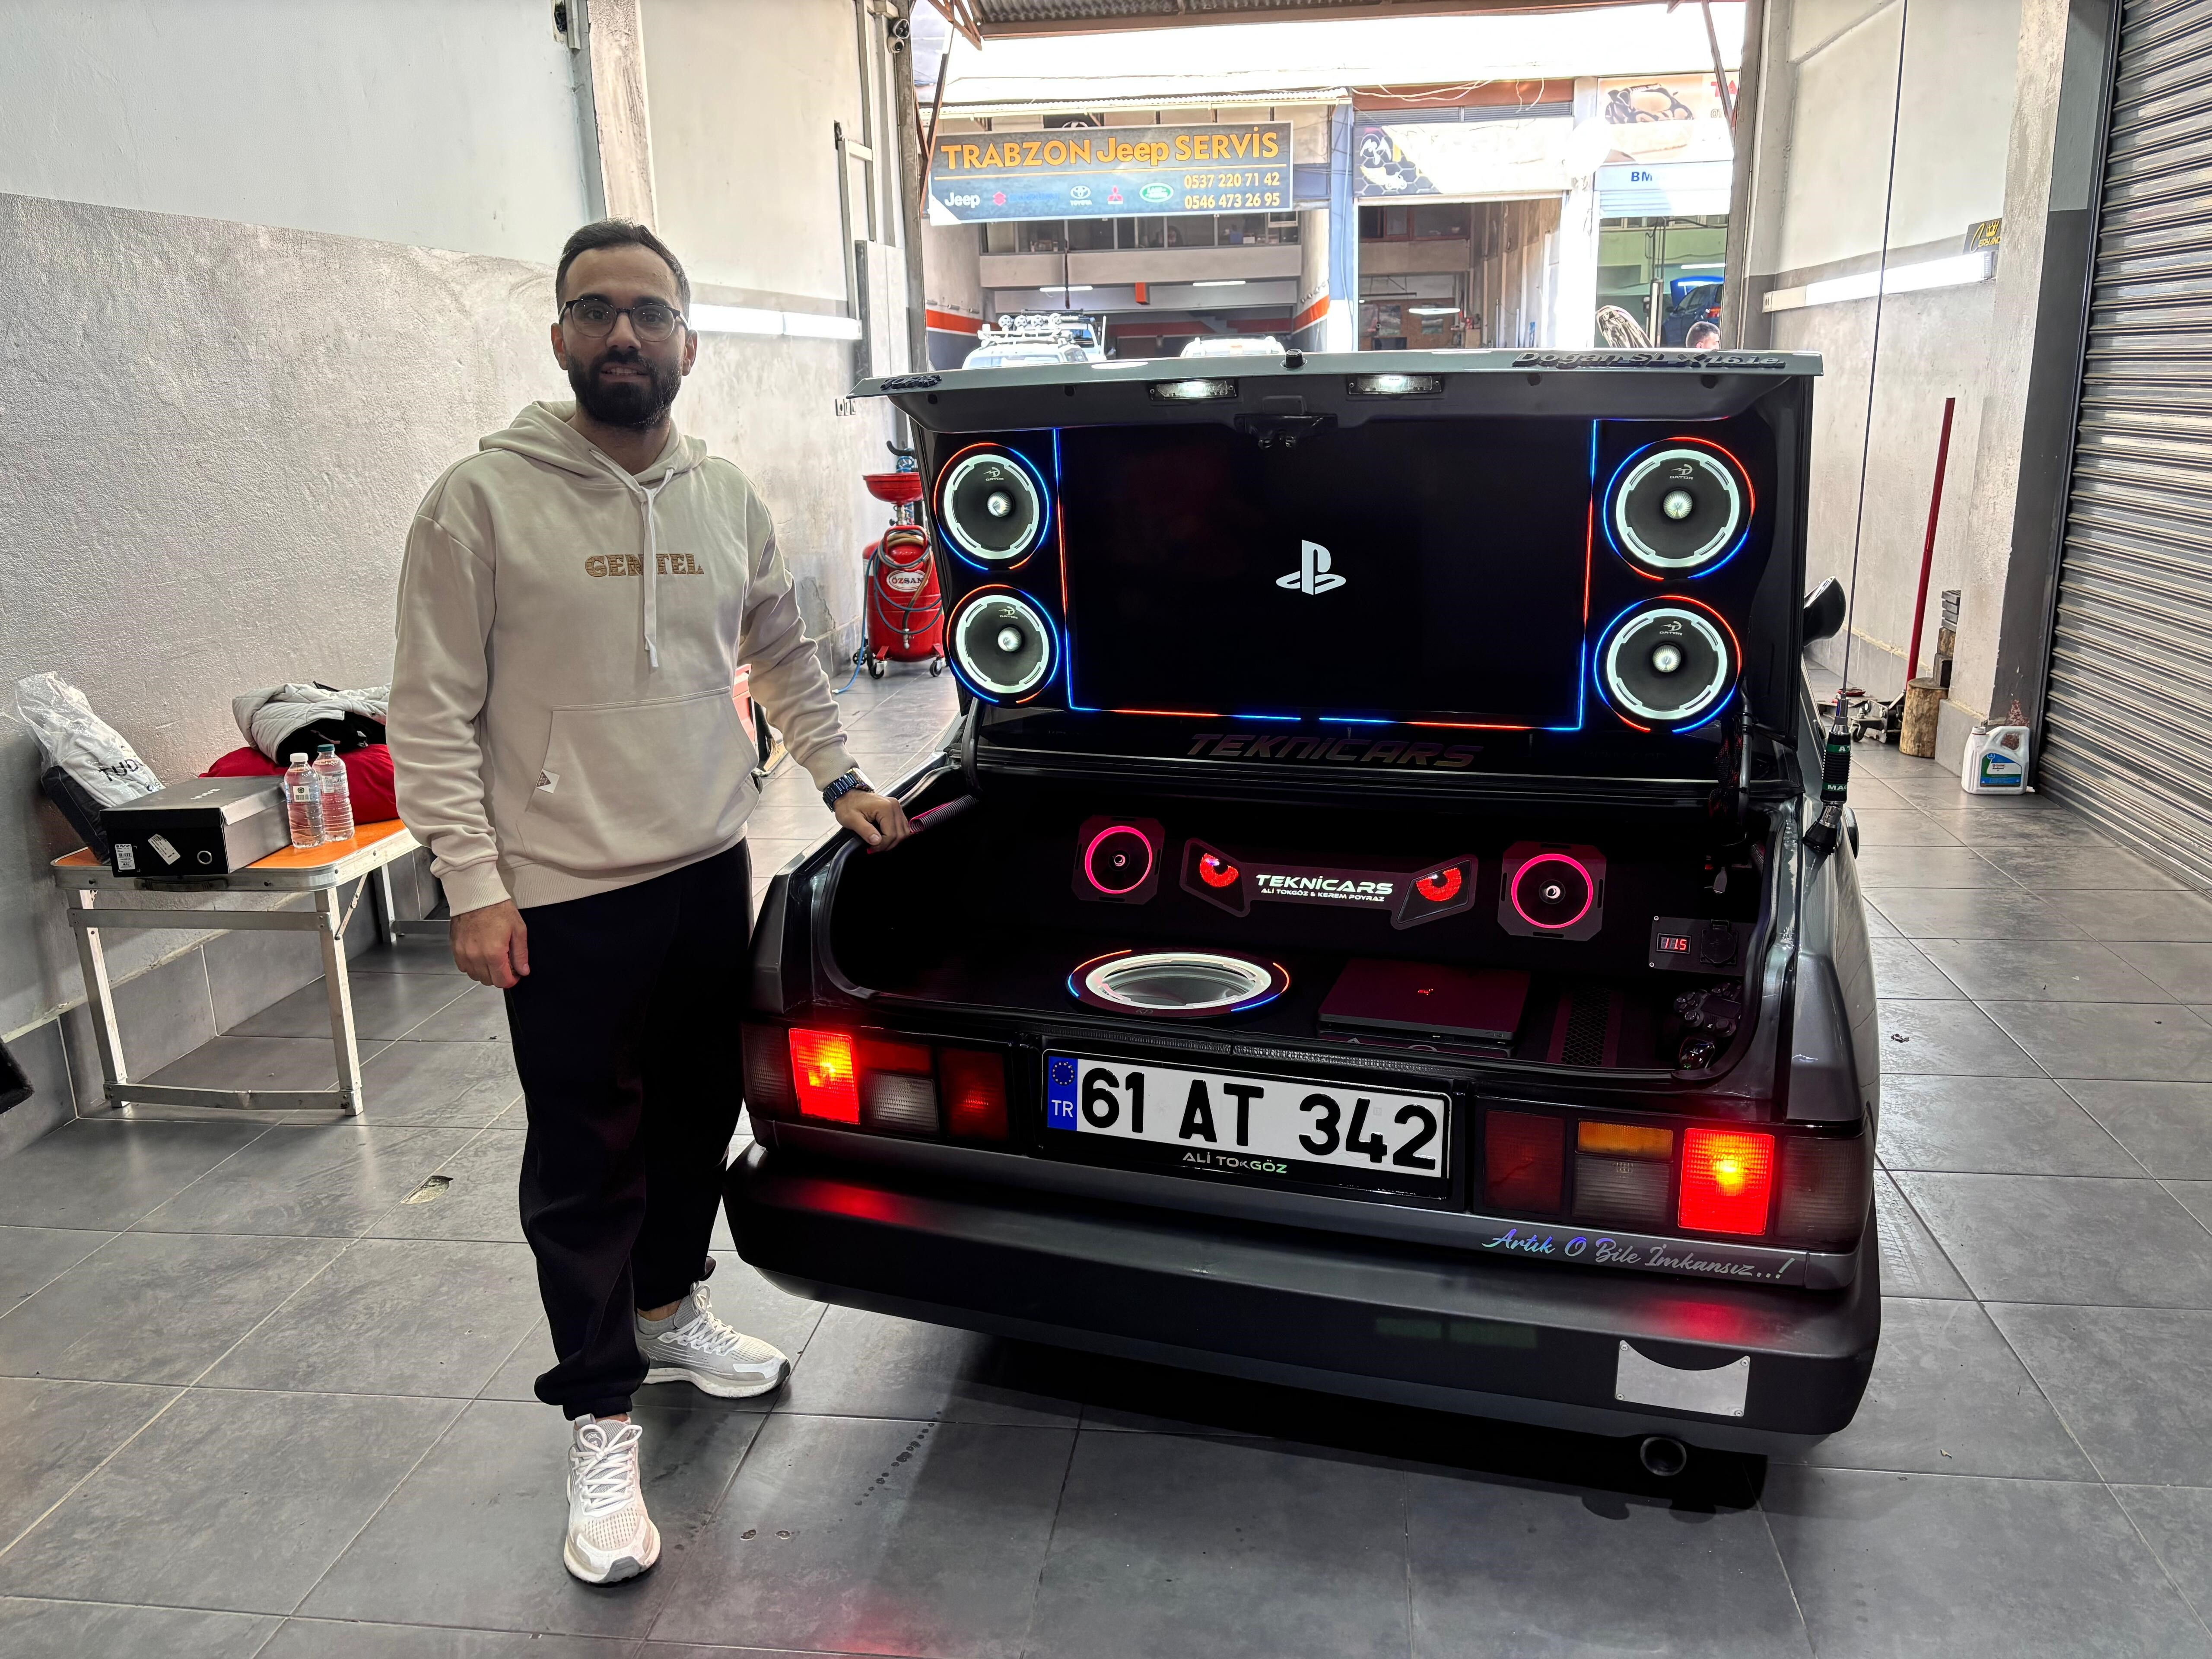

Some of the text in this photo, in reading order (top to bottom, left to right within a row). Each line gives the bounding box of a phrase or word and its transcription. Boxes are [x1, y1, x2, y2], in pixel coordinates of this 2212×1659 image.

[941, 126, 1279, 169] TRABZON Jeep SERVİS
[1184, 172, 1280, 188] 0537 220 71 42
[944, 192, 980, 208] Jeep
[1184, 195, 1215, 209] 0546
[1219, 194, 1242, 208] 473
[1245, 193, 1261, 207] 26
[1265, 192, 1280, 206] 95
[1052, 1068, 1437, 1170] TR 61 AT 342
[1182, 1152, 1287, 1173] ALİ TOKGÖZ
[1564, 1236, 1587, 1256] O
[1595, 1238, 1641, 1263] Bile
